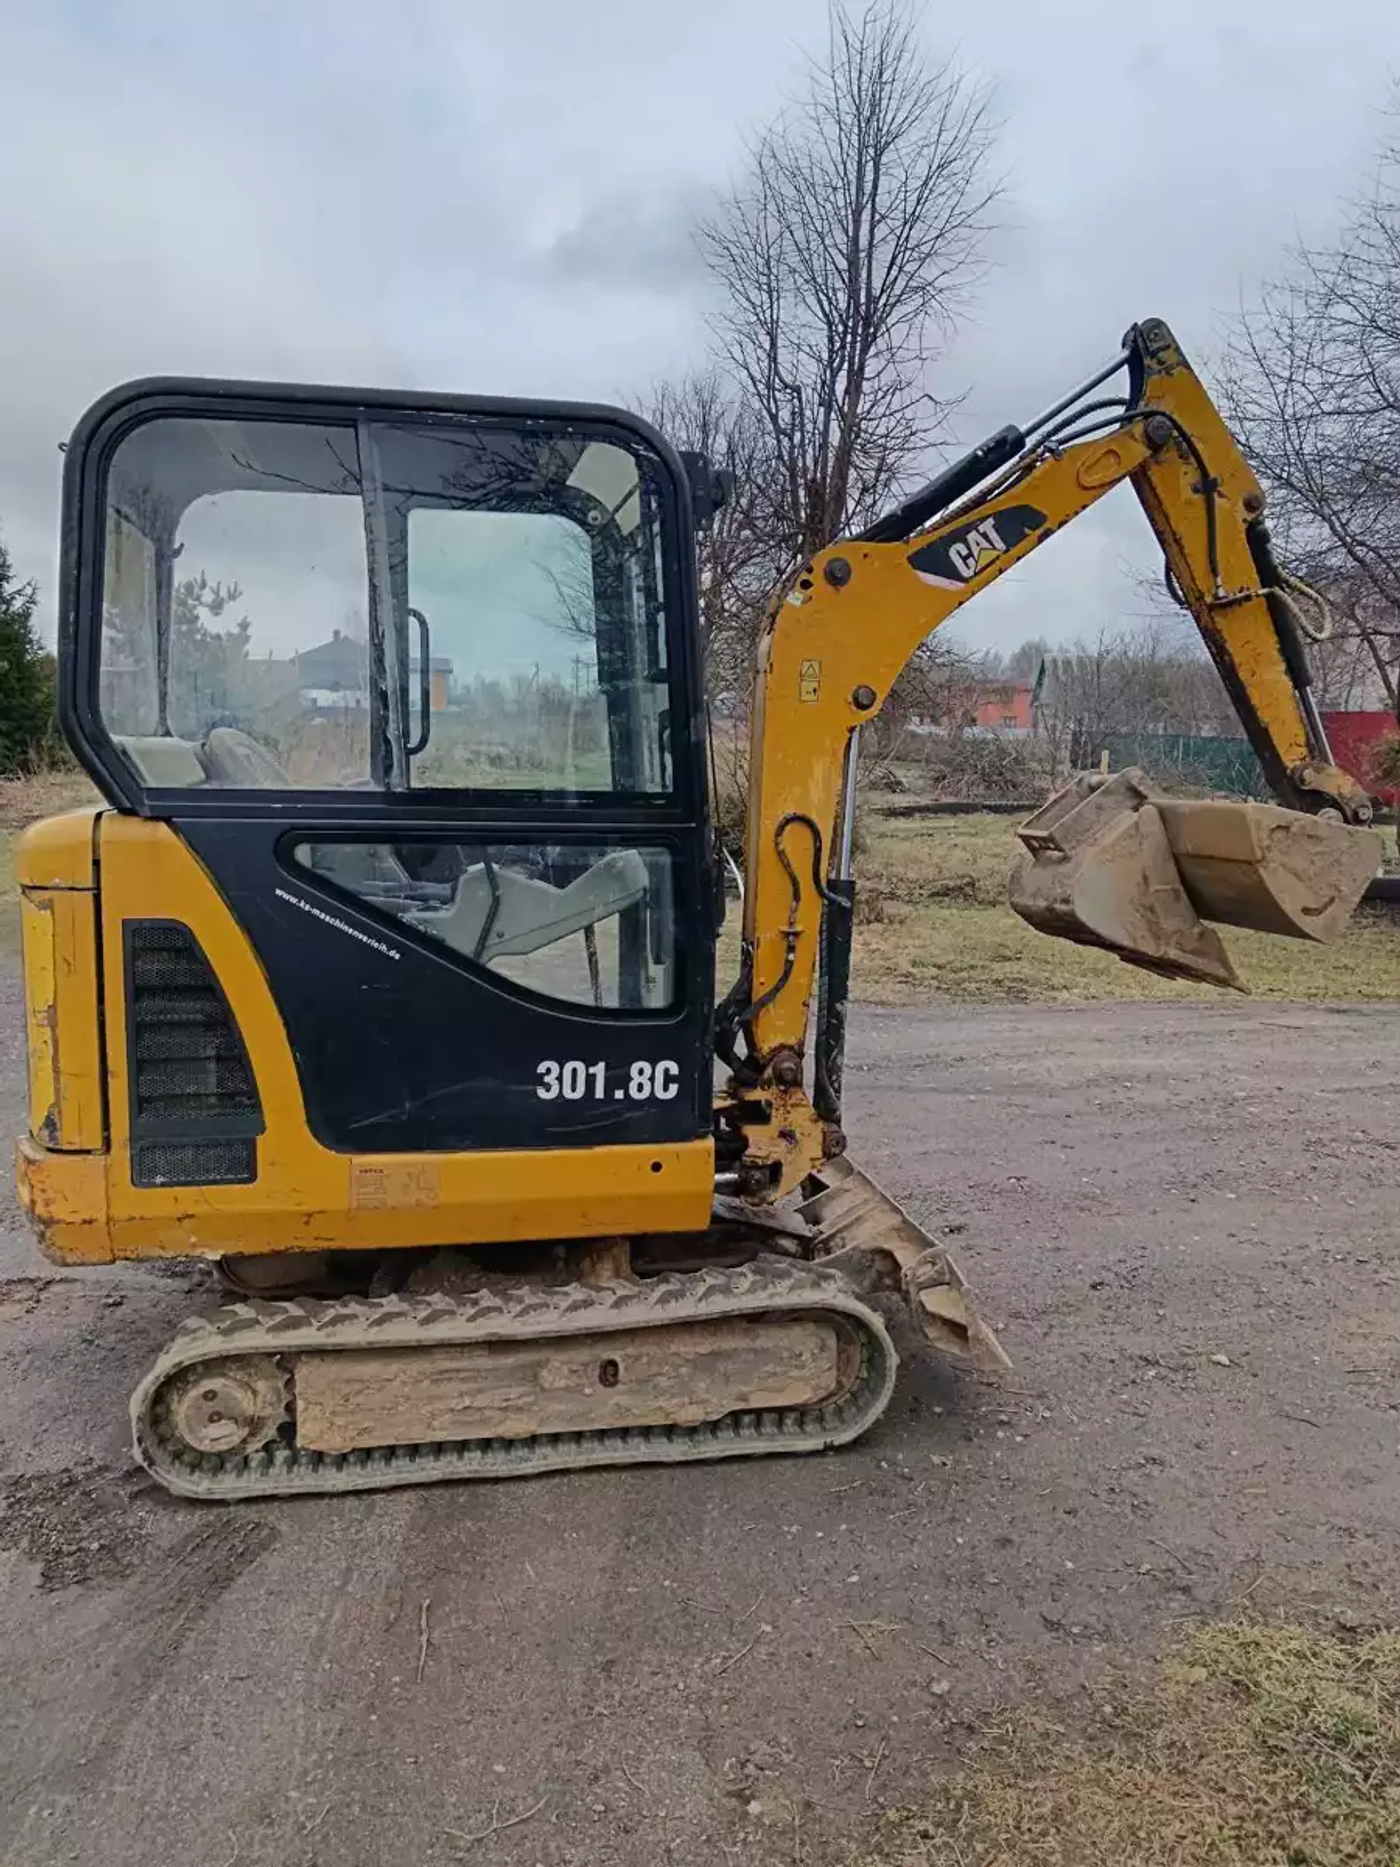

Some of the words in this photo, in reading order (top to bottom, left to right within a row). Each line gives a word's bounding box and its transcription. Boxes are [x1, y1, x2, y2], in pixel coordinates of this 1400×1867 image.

[948, 516, 1007, 579] CAT
[274, 887, 401, 960] www.ks-maschinenverleih.de
[536, 1060, 680, 1100] 301.8C
